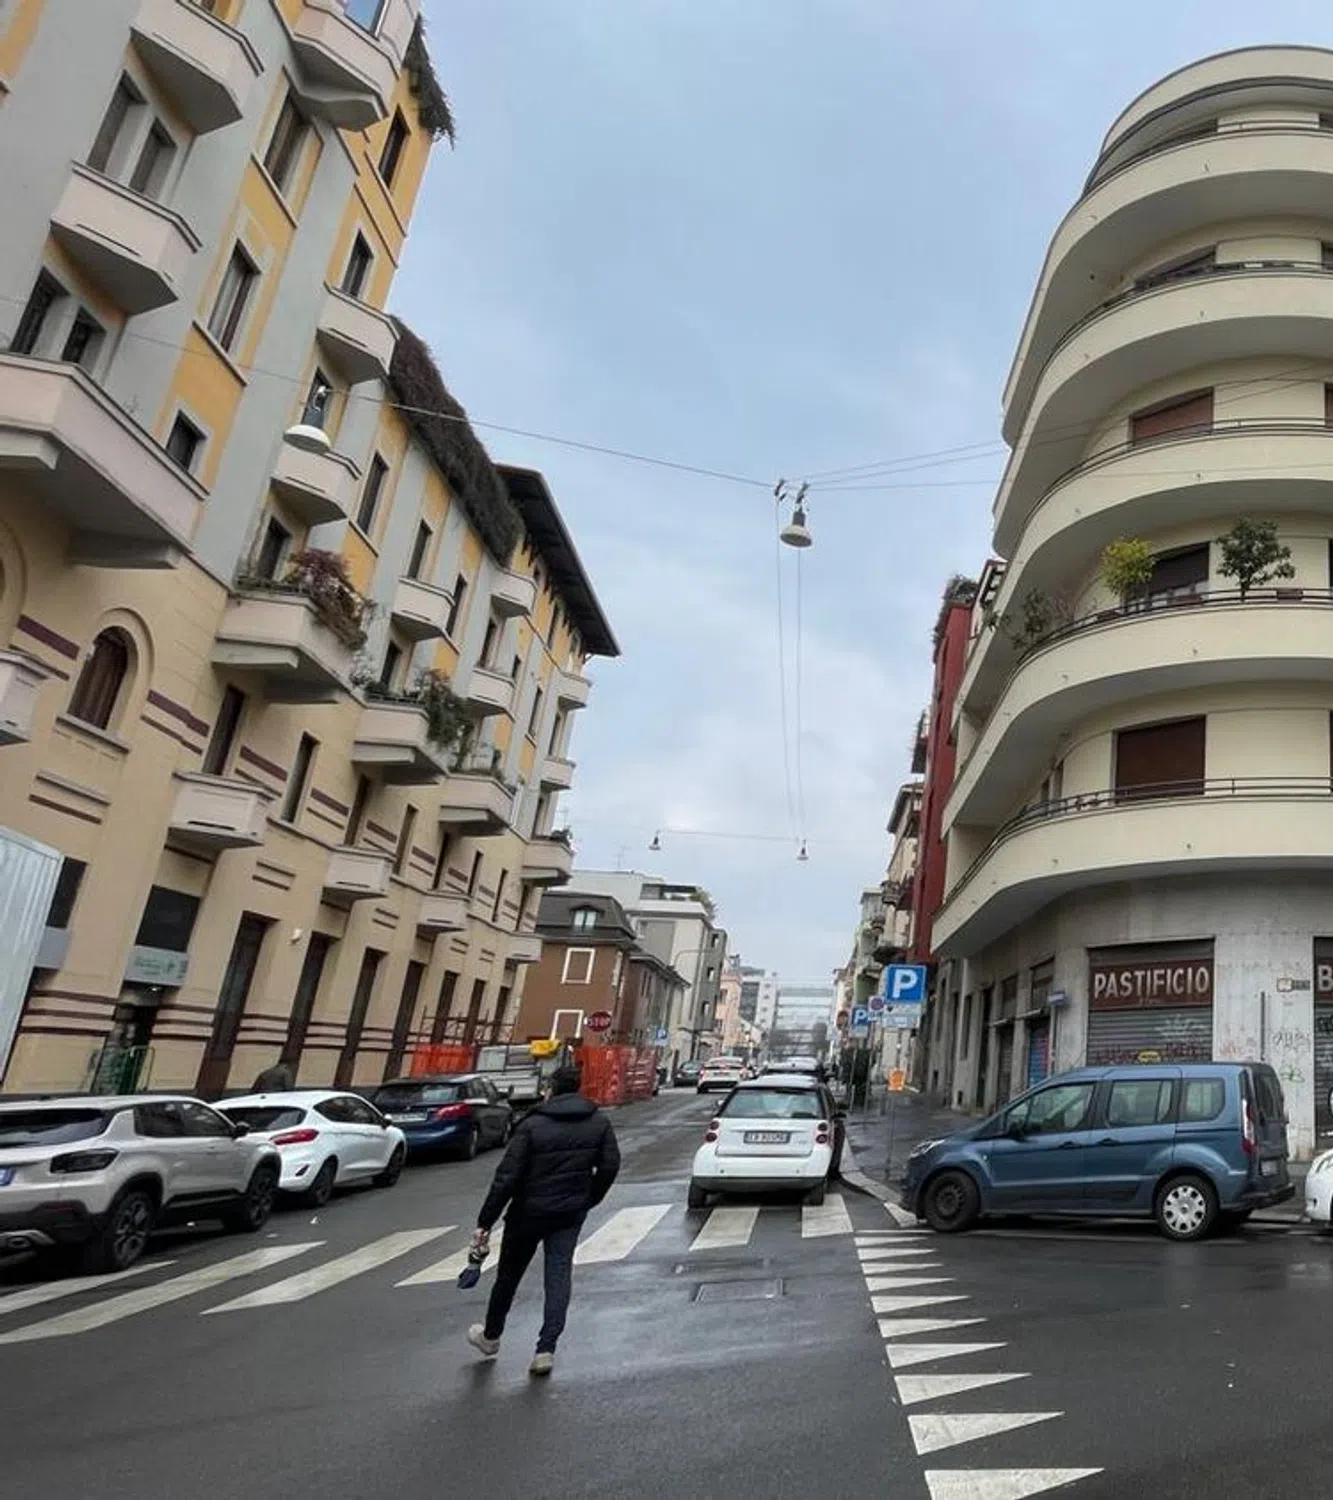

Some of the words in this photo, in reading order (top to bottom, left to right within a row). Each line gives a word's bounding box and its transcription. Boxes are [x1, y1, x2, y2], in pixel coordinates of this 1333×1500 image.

[892, 968, 918, 998] P
[1094, 966, 1209, 999] PASTIFICIO
[854, 1009, 867, 1024] P
